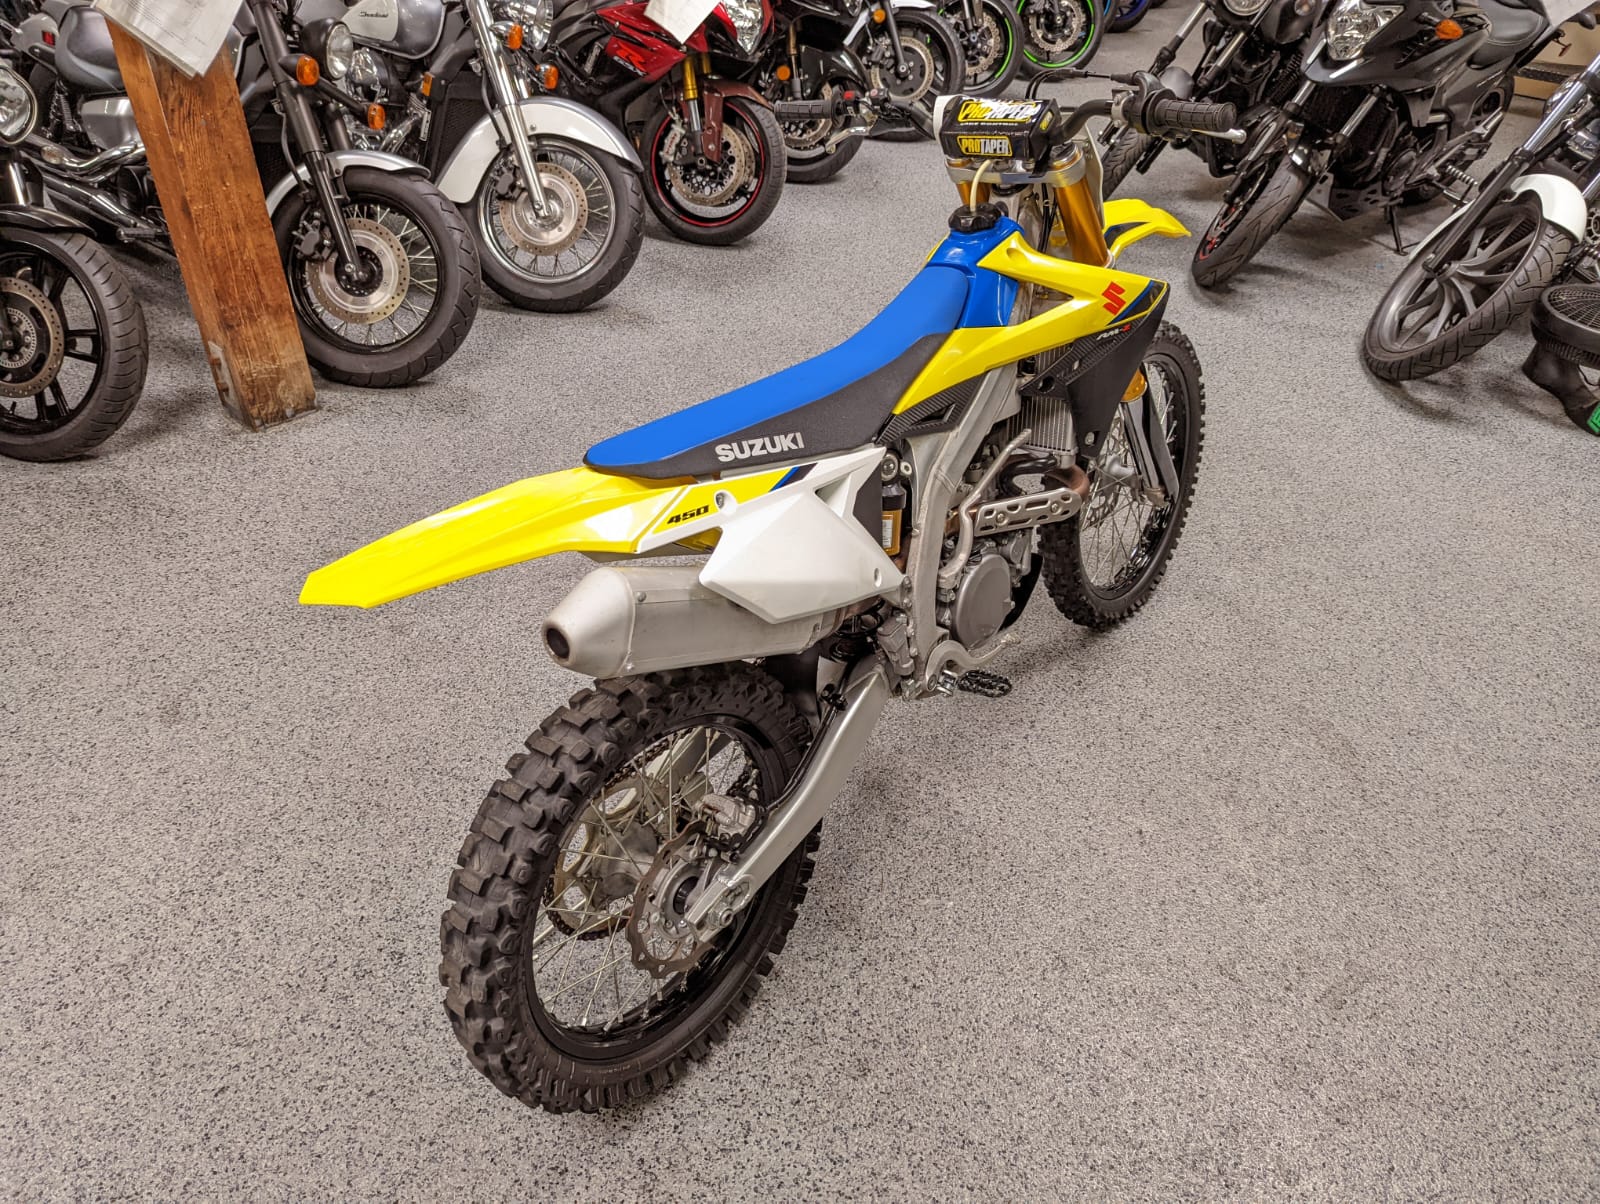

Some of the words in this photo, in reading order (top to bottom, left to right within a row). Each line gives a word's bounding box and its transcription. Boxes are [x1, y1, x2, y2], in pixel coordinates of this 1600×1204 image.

[960, 138, 1010, 155] PROTAPER
[714, 432, 805, 462] SUZUKI
[667, 505, 710, 525] 450
